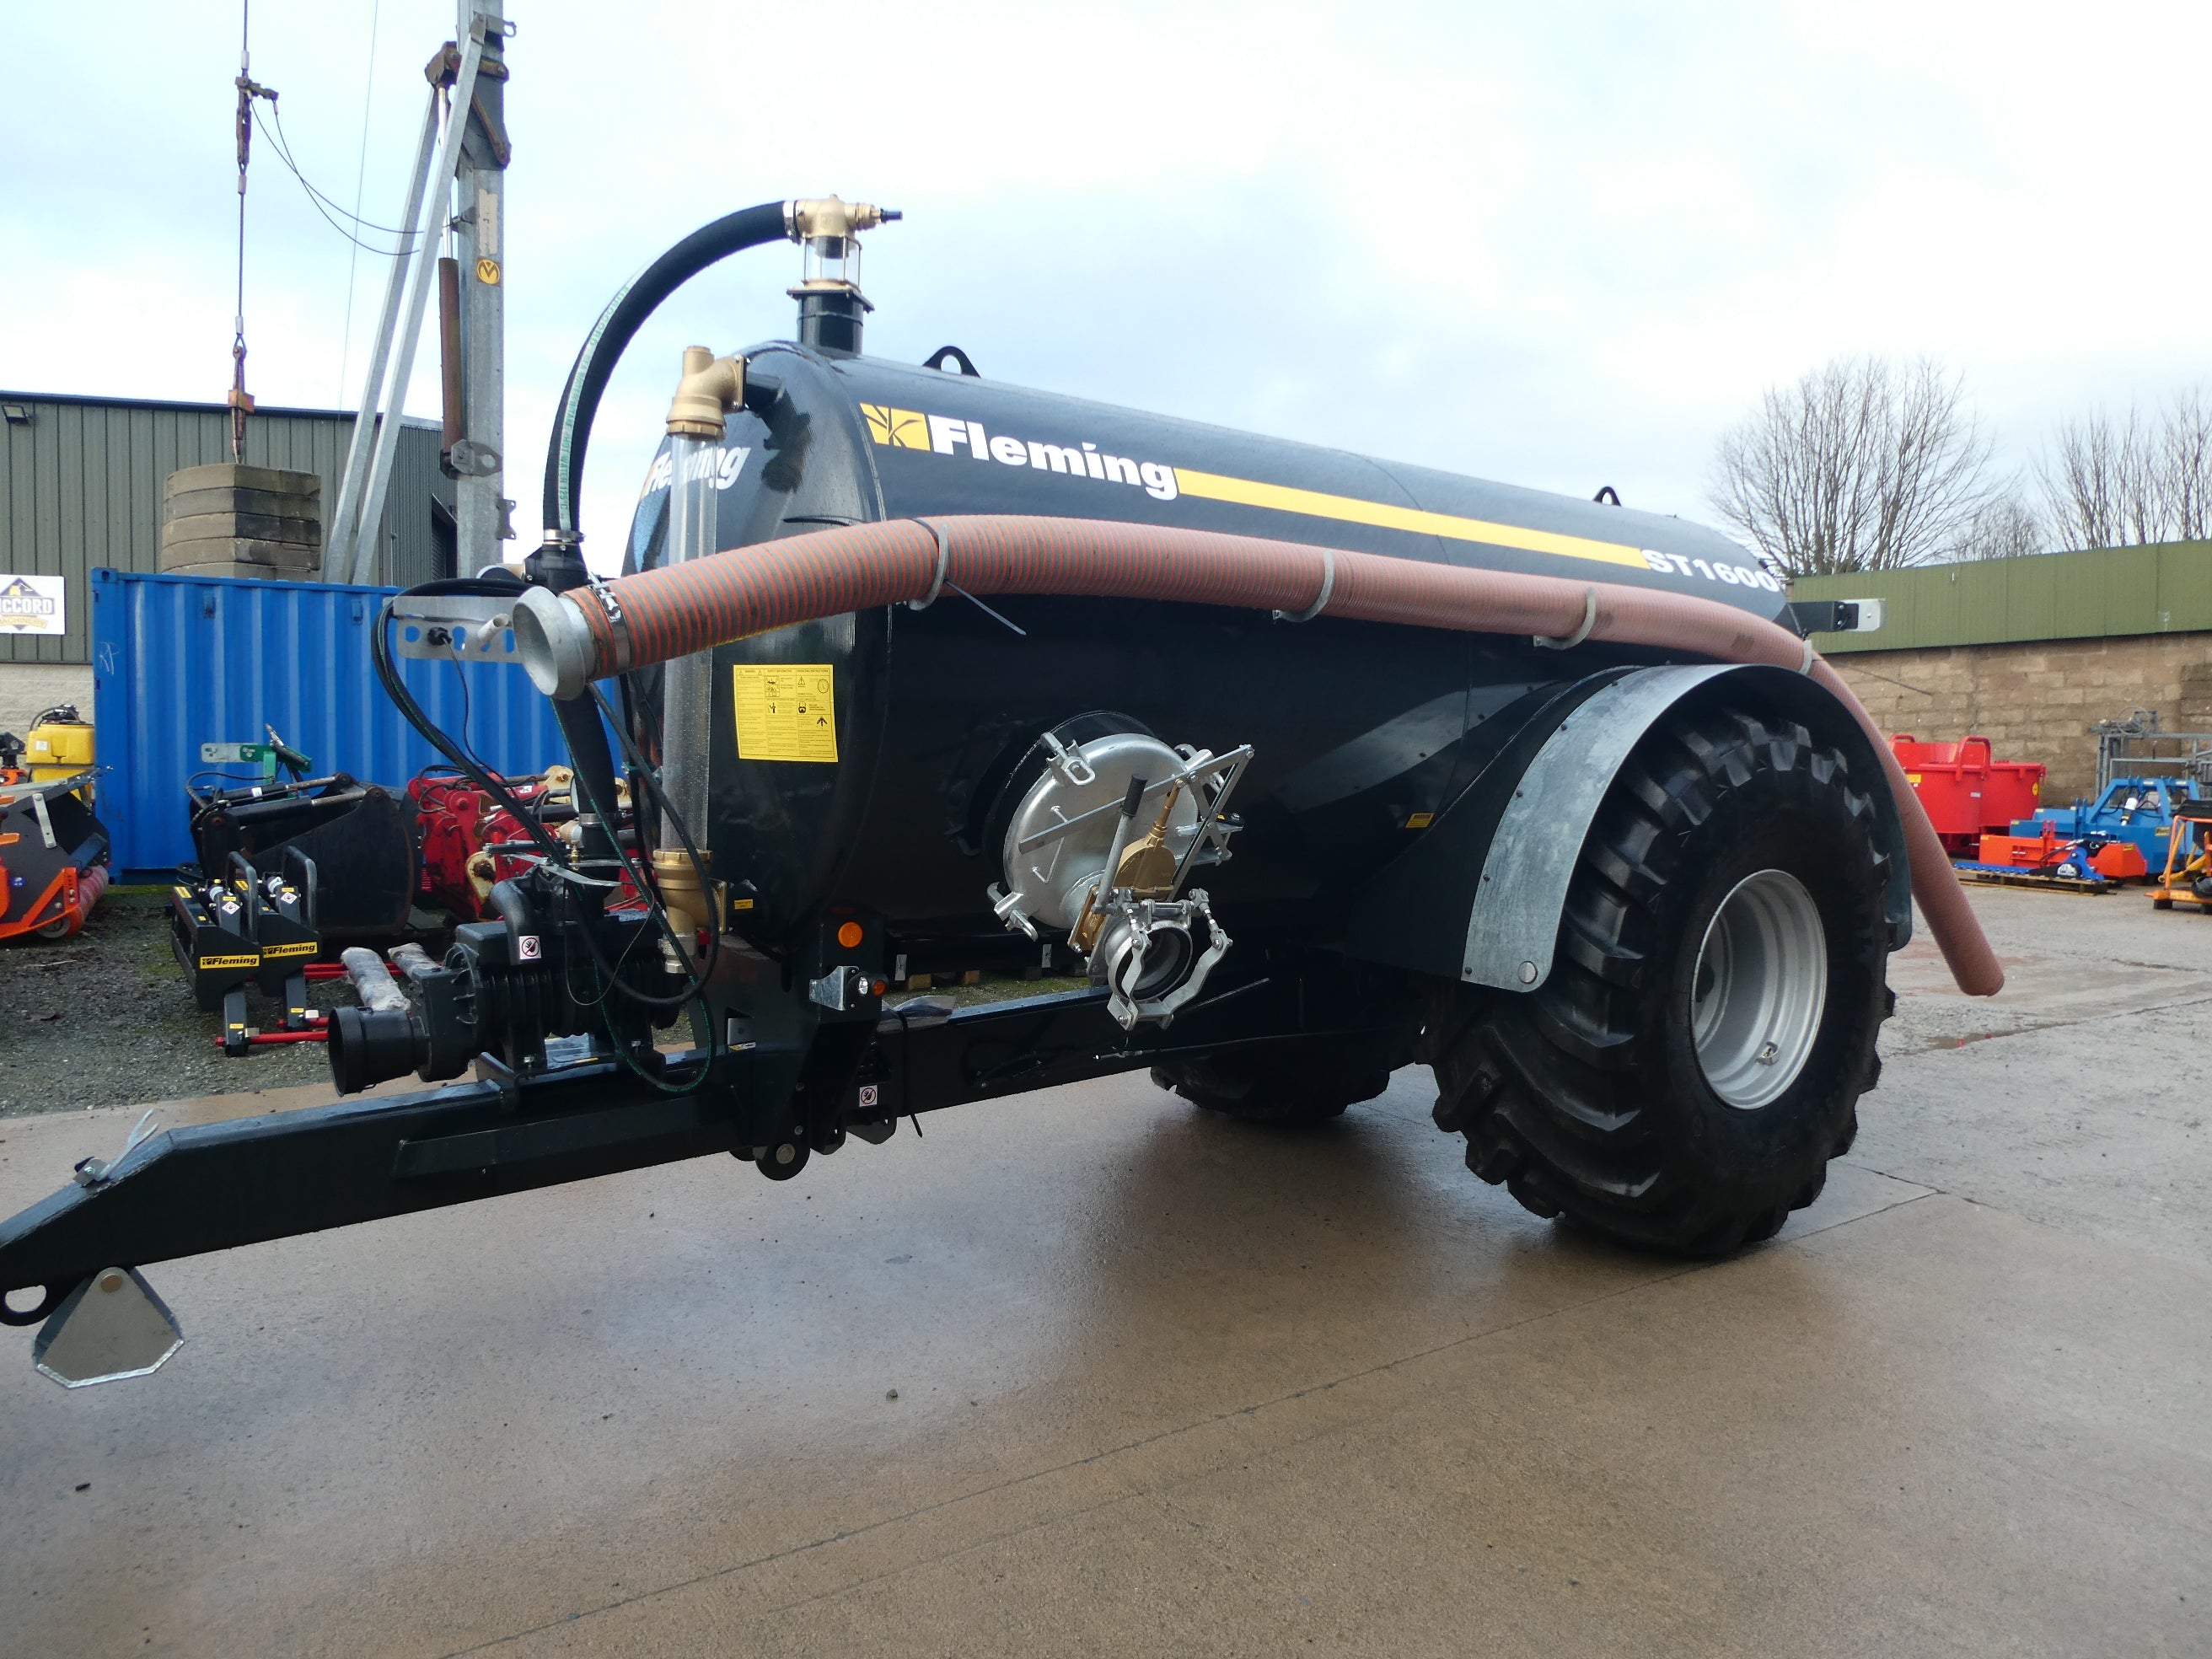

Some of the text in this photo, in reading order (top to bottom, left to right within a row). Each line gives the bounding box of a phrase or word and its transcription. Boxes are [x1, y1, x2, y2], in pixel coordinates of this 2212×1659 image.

[928, 414, 1178, 501] Fleming
[1641, 549, 1780, 593] ST1600
[0, 598, 52, 615] CCORD
[273, 943, 315, 955] Fleming
[212, 956, 258, 965] Fleming
